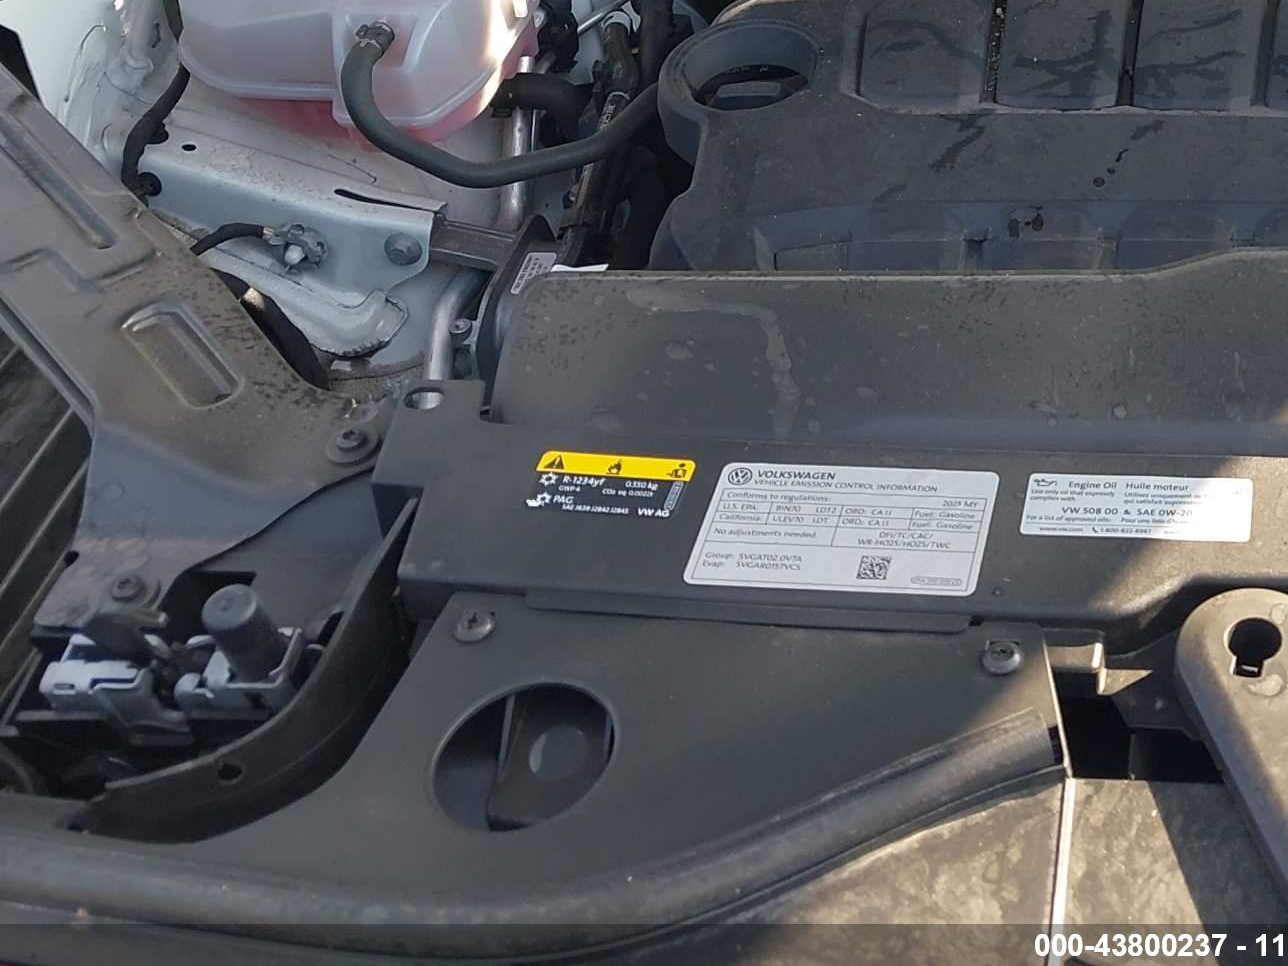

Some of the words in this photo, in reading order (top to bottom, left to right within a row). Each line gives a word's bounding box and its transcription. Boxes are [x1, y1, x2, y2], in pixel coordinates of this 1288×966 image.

[757, 470, 836, 480] VOLKSWAGEN
[562, 476, 606, 488] R-1234yf
[647, 481, 659, 491] kg
[1068, 480, 1101, 490] Engine
[1103, 481, 1117, 489] Oil
[1125, 482, 1151, 490] Huile
[1153, 483, 1189, 491] moteur
[834, 482, 874, 490] CONTROL
[876, 483, 938, 493] INFORMATION
[552, 495, 574, 504] PAG
[727, 491, 768, 500] Conforms
[771, 492, 779, 500] to
[781, 493, 831, 502] regulations:
[942, 500, 962, 508] 2025
[637, 508, 655, 517] VW
[656, 509, 670, 518] AG
[914, 510, 934, 518] Fuel:
[938, 511, 977, 519] Gasoline
[1061, 506, 1081, 514] VW
[1083, 507, 1102, 515] 508
[1136, 508, 1156, 516] SAE
[1158, 509, 1193, 517] 0W-20
[935, 522, 974, 530] Gasoline
[714, 527, 727, 535] No
[728, 528, 782, 537] adjustments
[783, 530, 816, 539] needed
